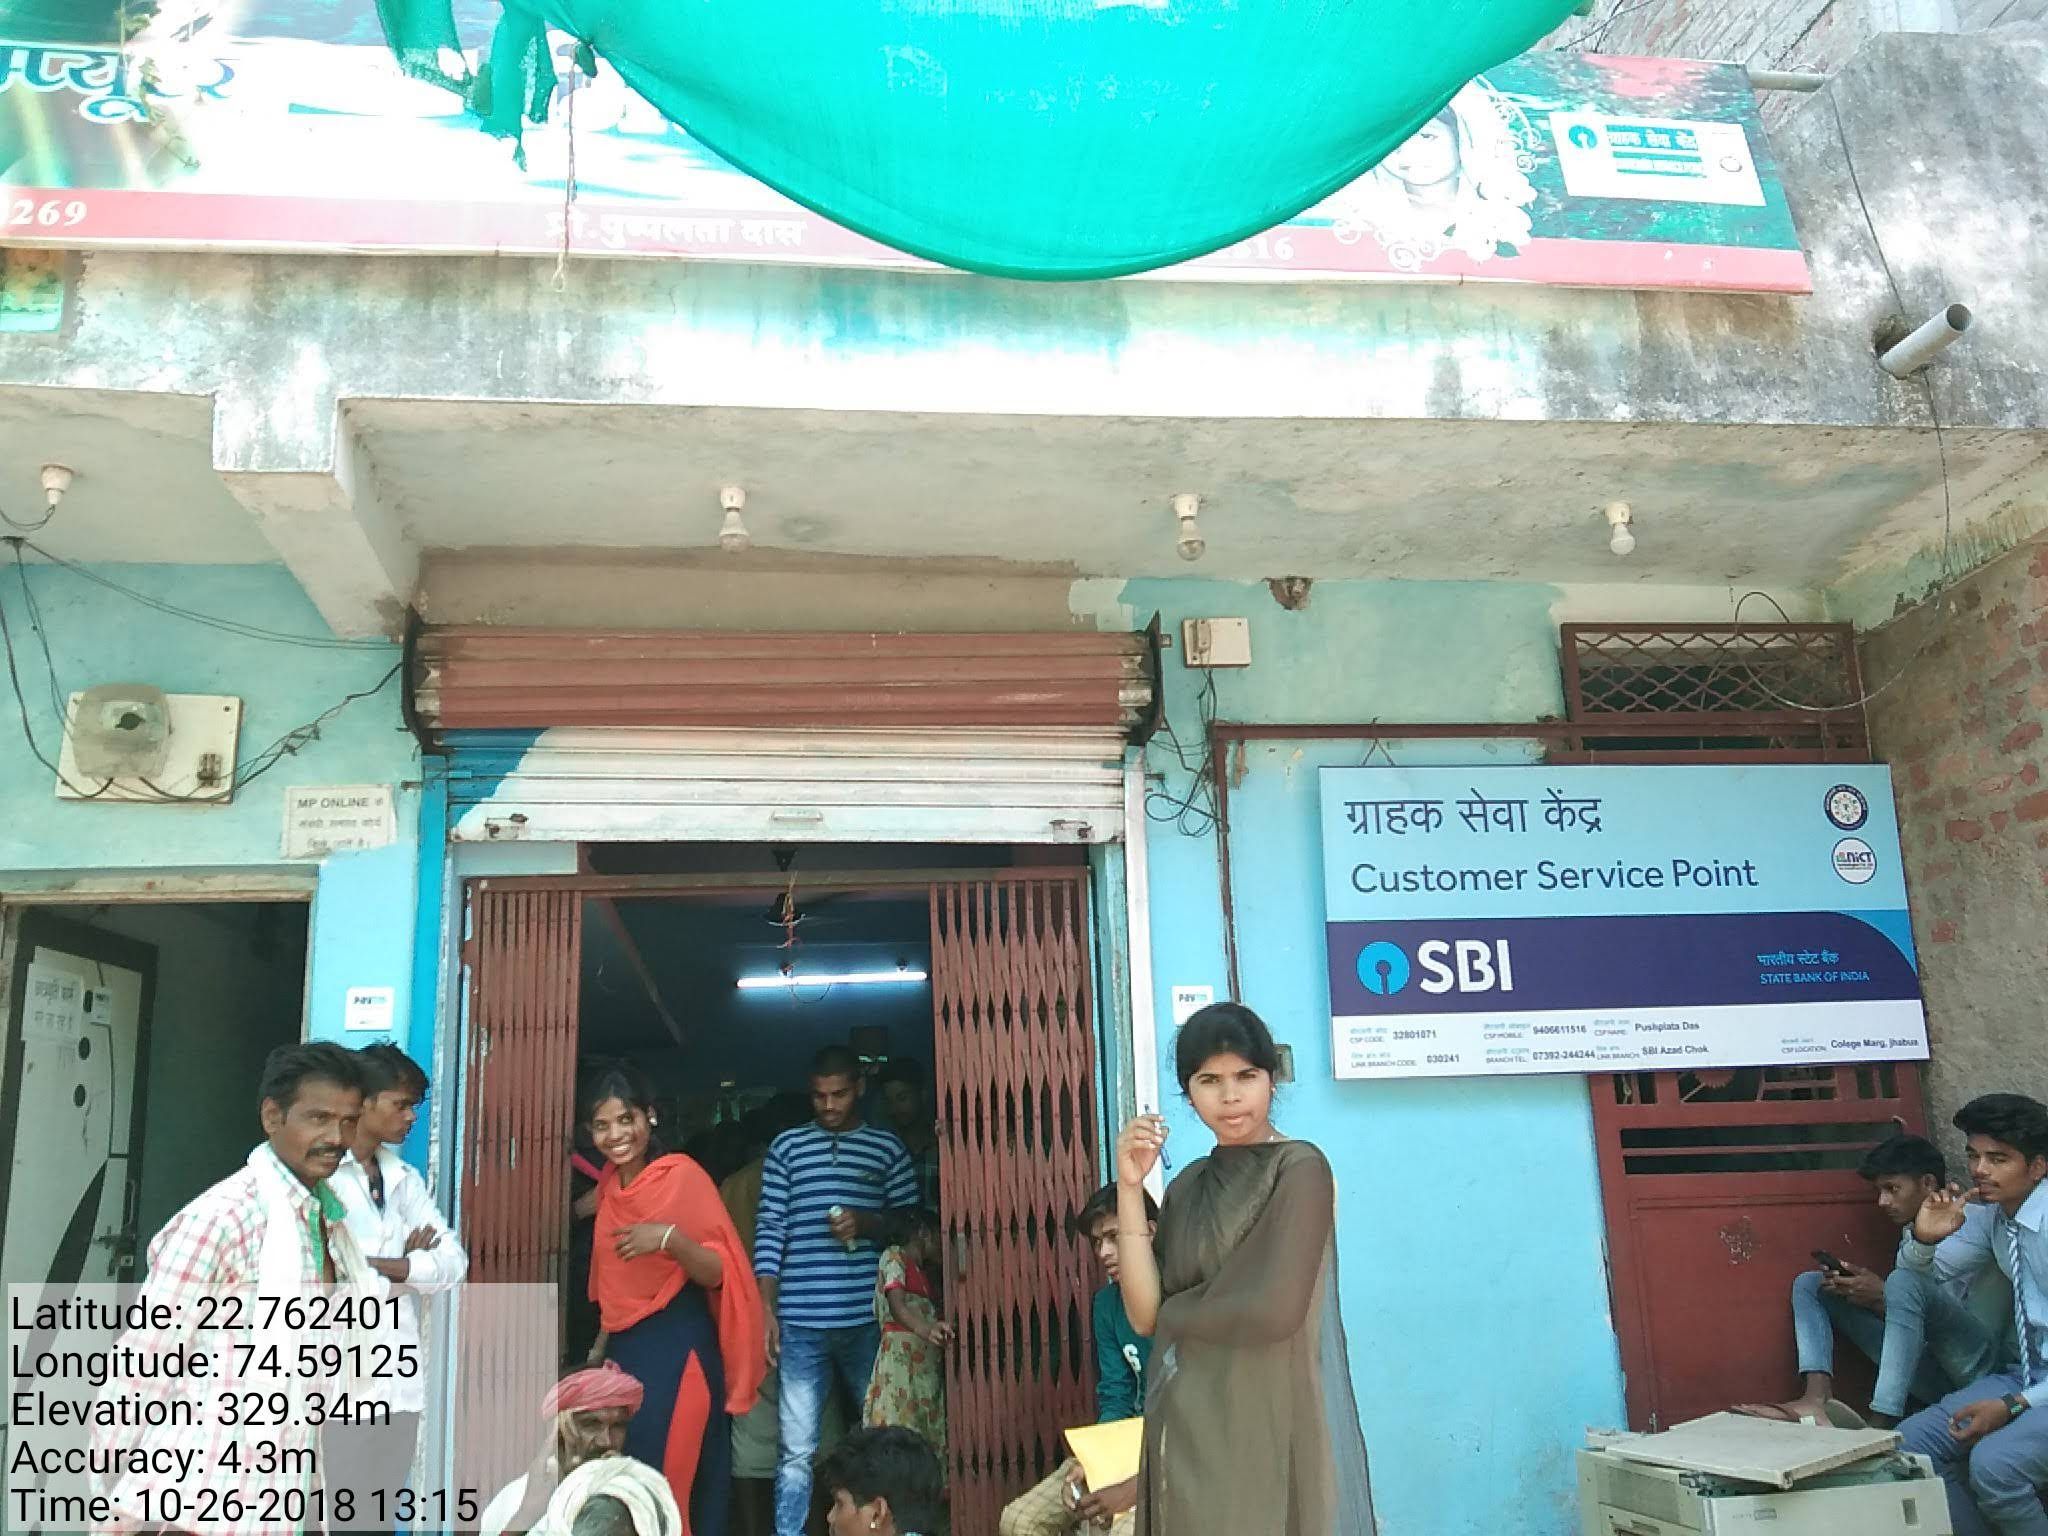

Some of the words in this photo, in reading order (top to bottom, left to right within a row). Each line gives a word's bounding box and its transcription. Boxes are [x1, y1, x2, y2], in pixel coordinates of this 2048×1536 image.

[1344, 801, 1443, 834] ग्राहक
[1456, 788, 1529, 833] सेवा
[1541, 788, 1602, 834] केंद्र
[1352, 863, 1528, 893] Customer
[1537, 858, 1664, 889] Service
[1672, 858, 1760, 888] Point
[1417, 939, 1513, 993] SBI
[1757, 951, 1794, 966] भारतीय
[1760, 973, 1792, 984] STATE
[1794, 973, 1822, 983] BANK
[1823, 972, 1838, 982] OF
[1840, 971, 1870, 981] INDIA
